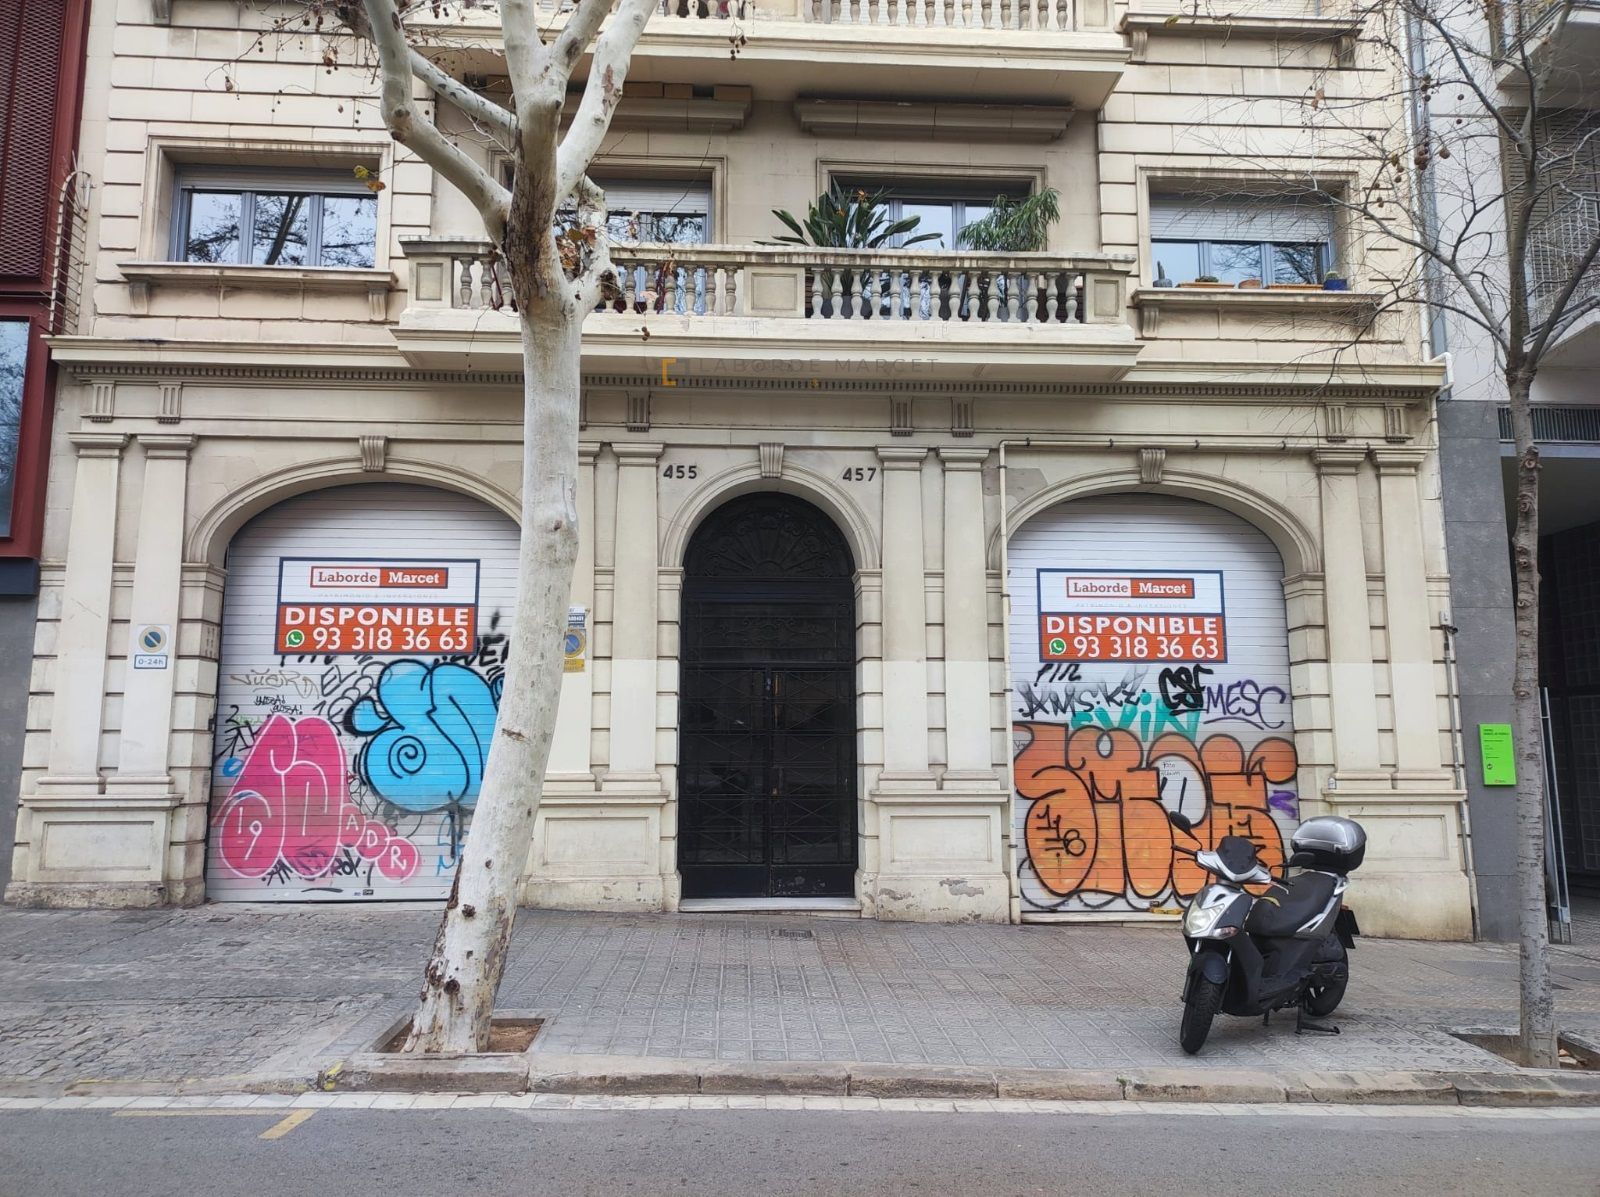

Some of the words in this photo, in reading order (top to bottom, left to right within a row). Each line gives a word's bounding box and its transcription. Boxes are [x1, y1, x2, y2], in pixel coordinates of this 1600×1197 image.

[662, 464, 698, 480] 455
[842, 467, 877, 482] 457
[317, 570, 378, 583] Laborde
[387, 571, 440, 585] Marcet
[1073, 582, 1129, 593] Laborde
[1138, 582, 1187, 595] Marcet
[285, 606, 470, 626] DISPONIBLE
[1046, 616, 1218, 635] DISPONIBLE
[312, 627, 341, 650] 93
[351, 627, 393, 650] 318
[401, 627, 431, 650] 36
[438, 627, 468, 650] 63
[1073, 635, 1100, 657] 93
[1109, 635, 1149, 658] 318
[1156, 636, 1184, 658] 36
[1191, 636, 1219, 659] 63
